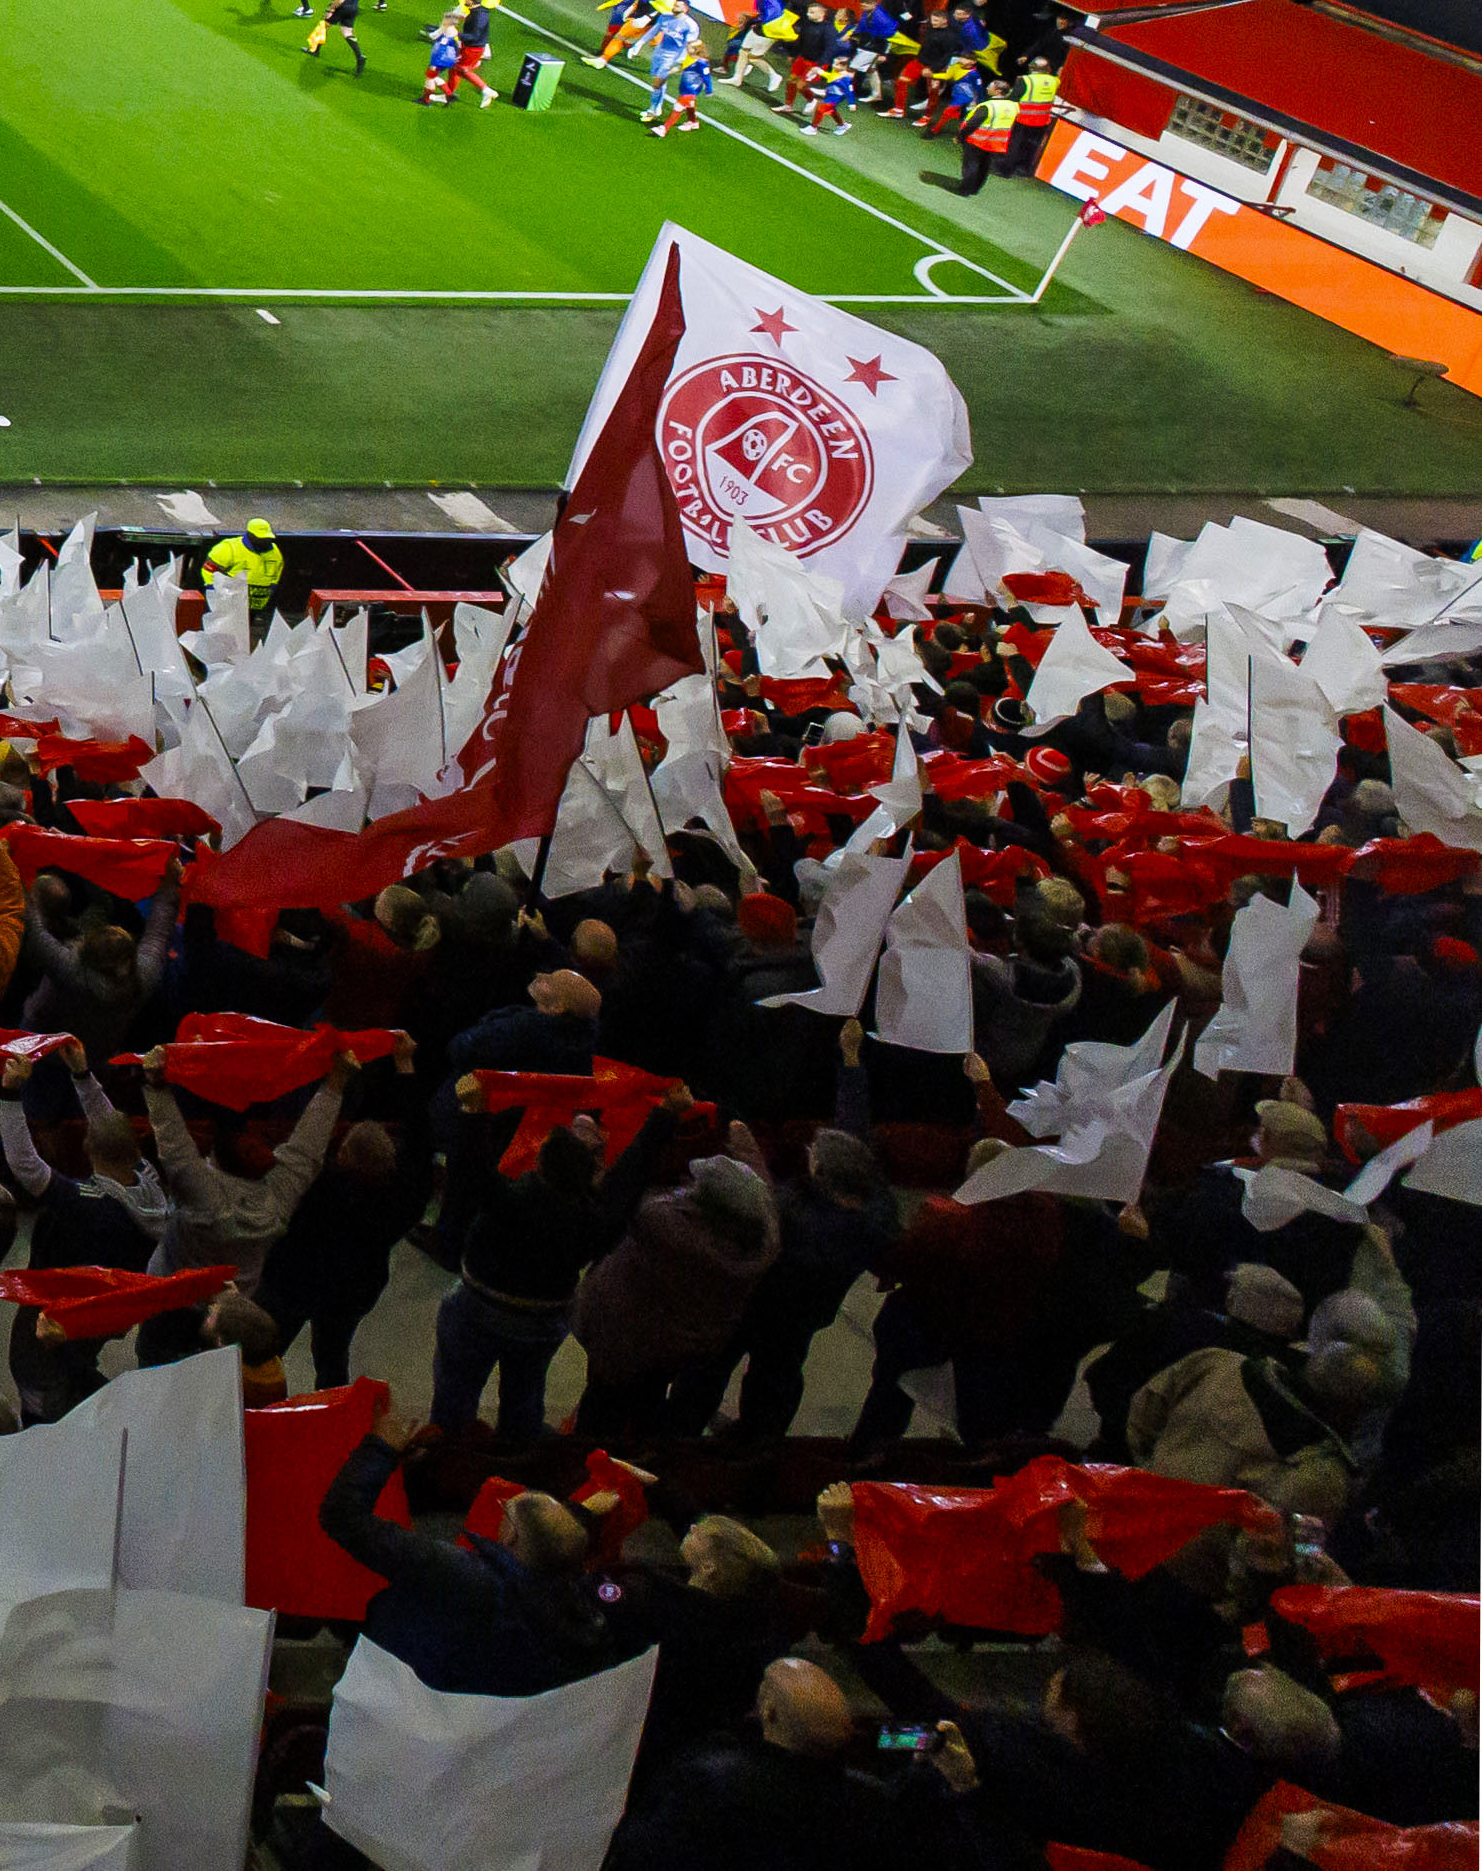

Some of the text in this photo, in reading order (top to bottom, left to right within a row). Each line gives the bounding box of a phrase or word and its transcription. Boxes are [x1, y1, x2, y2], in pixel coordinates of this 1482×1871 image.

[1050, 131, 1242, 251] EAT
[719, 366, 859, 461] ABERDEEN
[719, 474, 750, 507] 1903
[770, 454, 813, 485] FC
